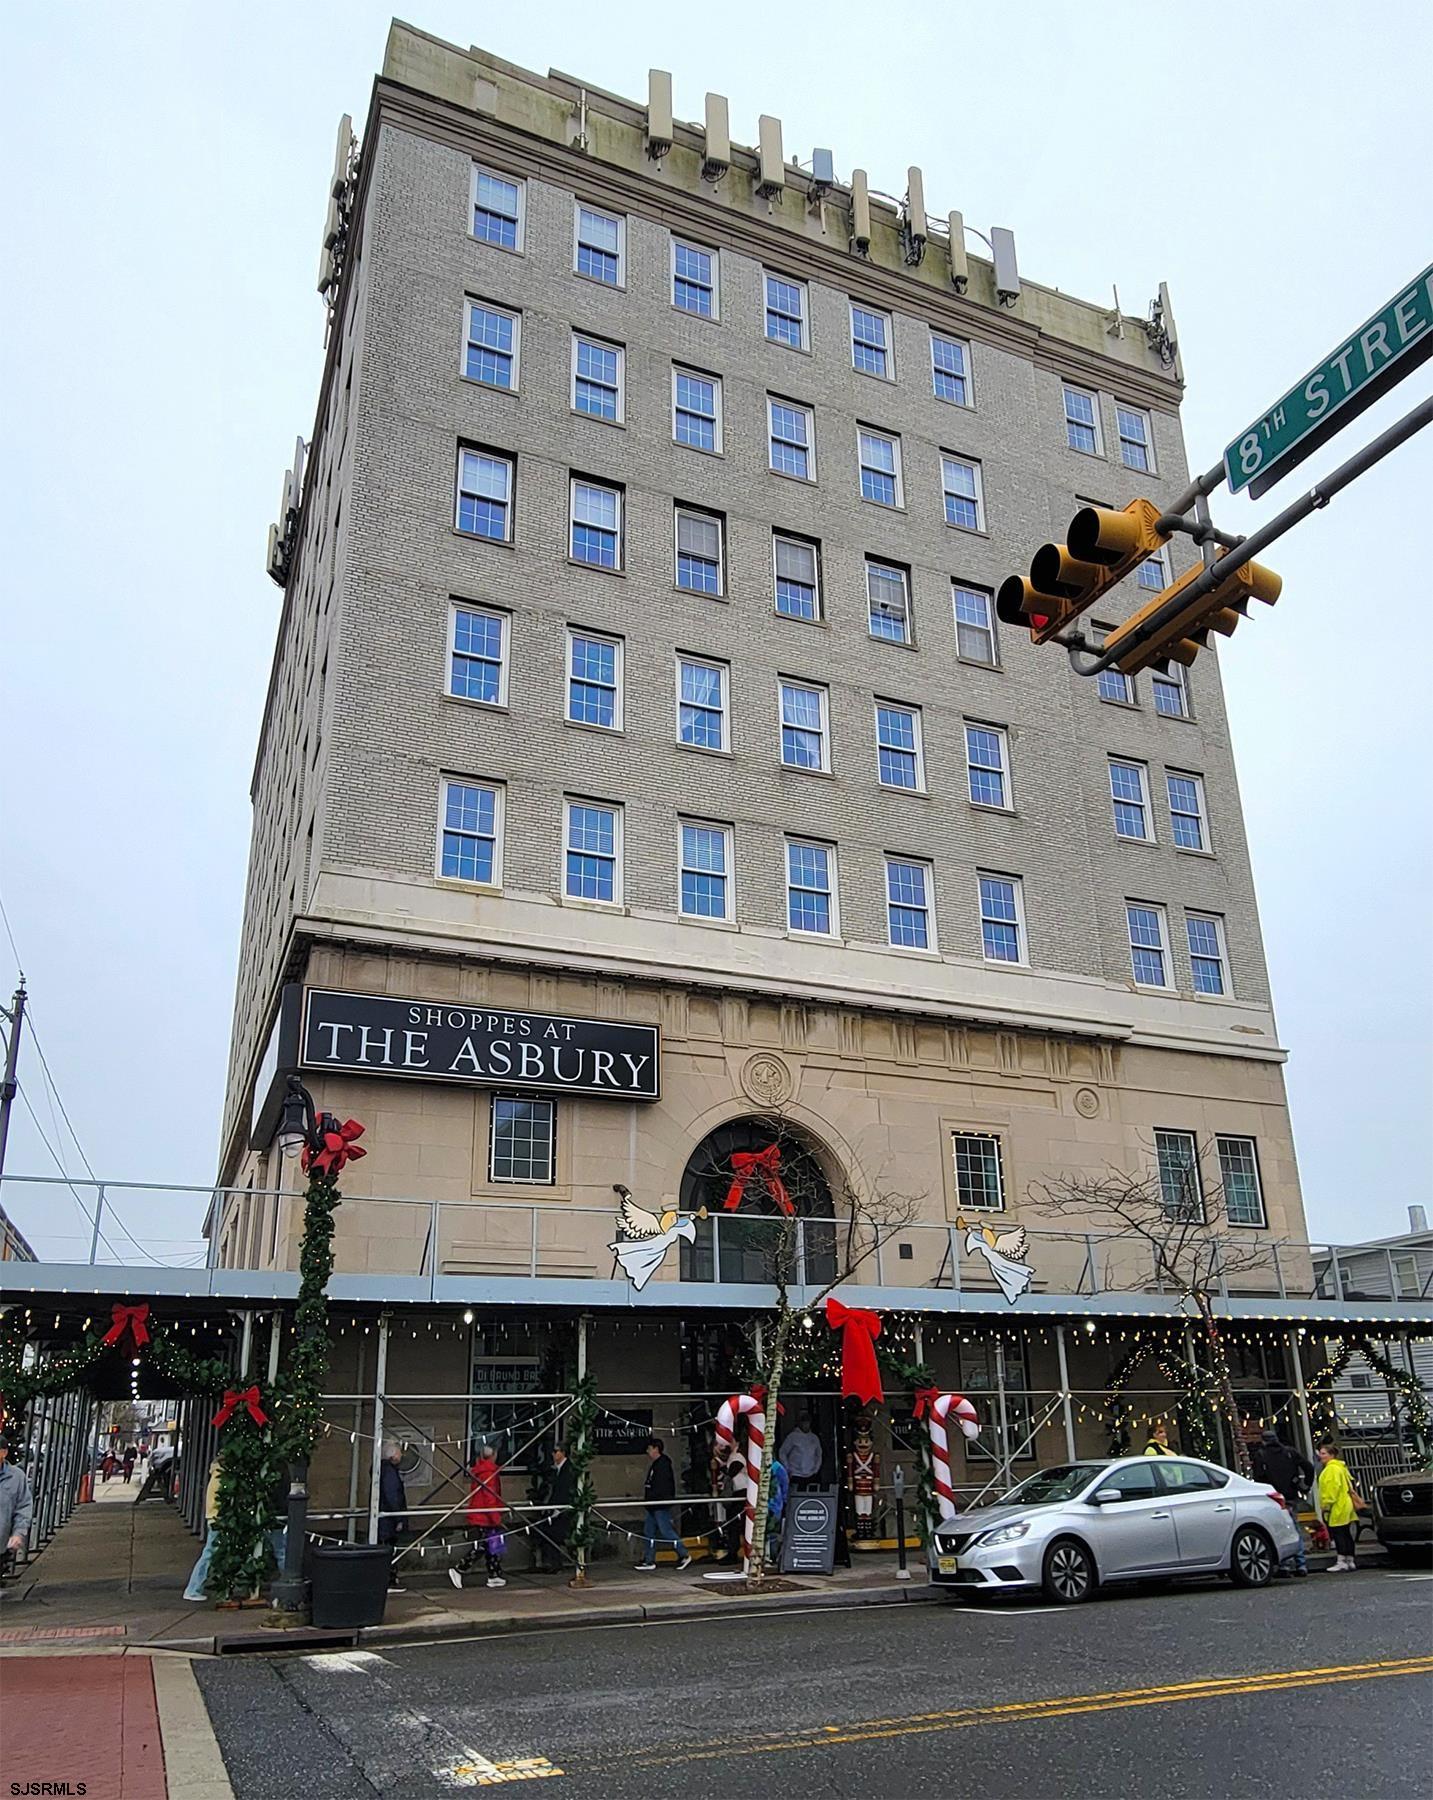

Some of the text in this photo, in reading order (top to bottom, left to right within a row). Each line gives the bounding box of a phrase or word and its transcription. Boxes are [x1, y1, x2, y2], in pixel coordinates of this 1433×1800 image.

[1239, 272, 1433, 475] 8TH STRE
[317, 1021, 652, 1089] THE ASBURY
[408, 1006, 576, 1041] SHOPPES AT
